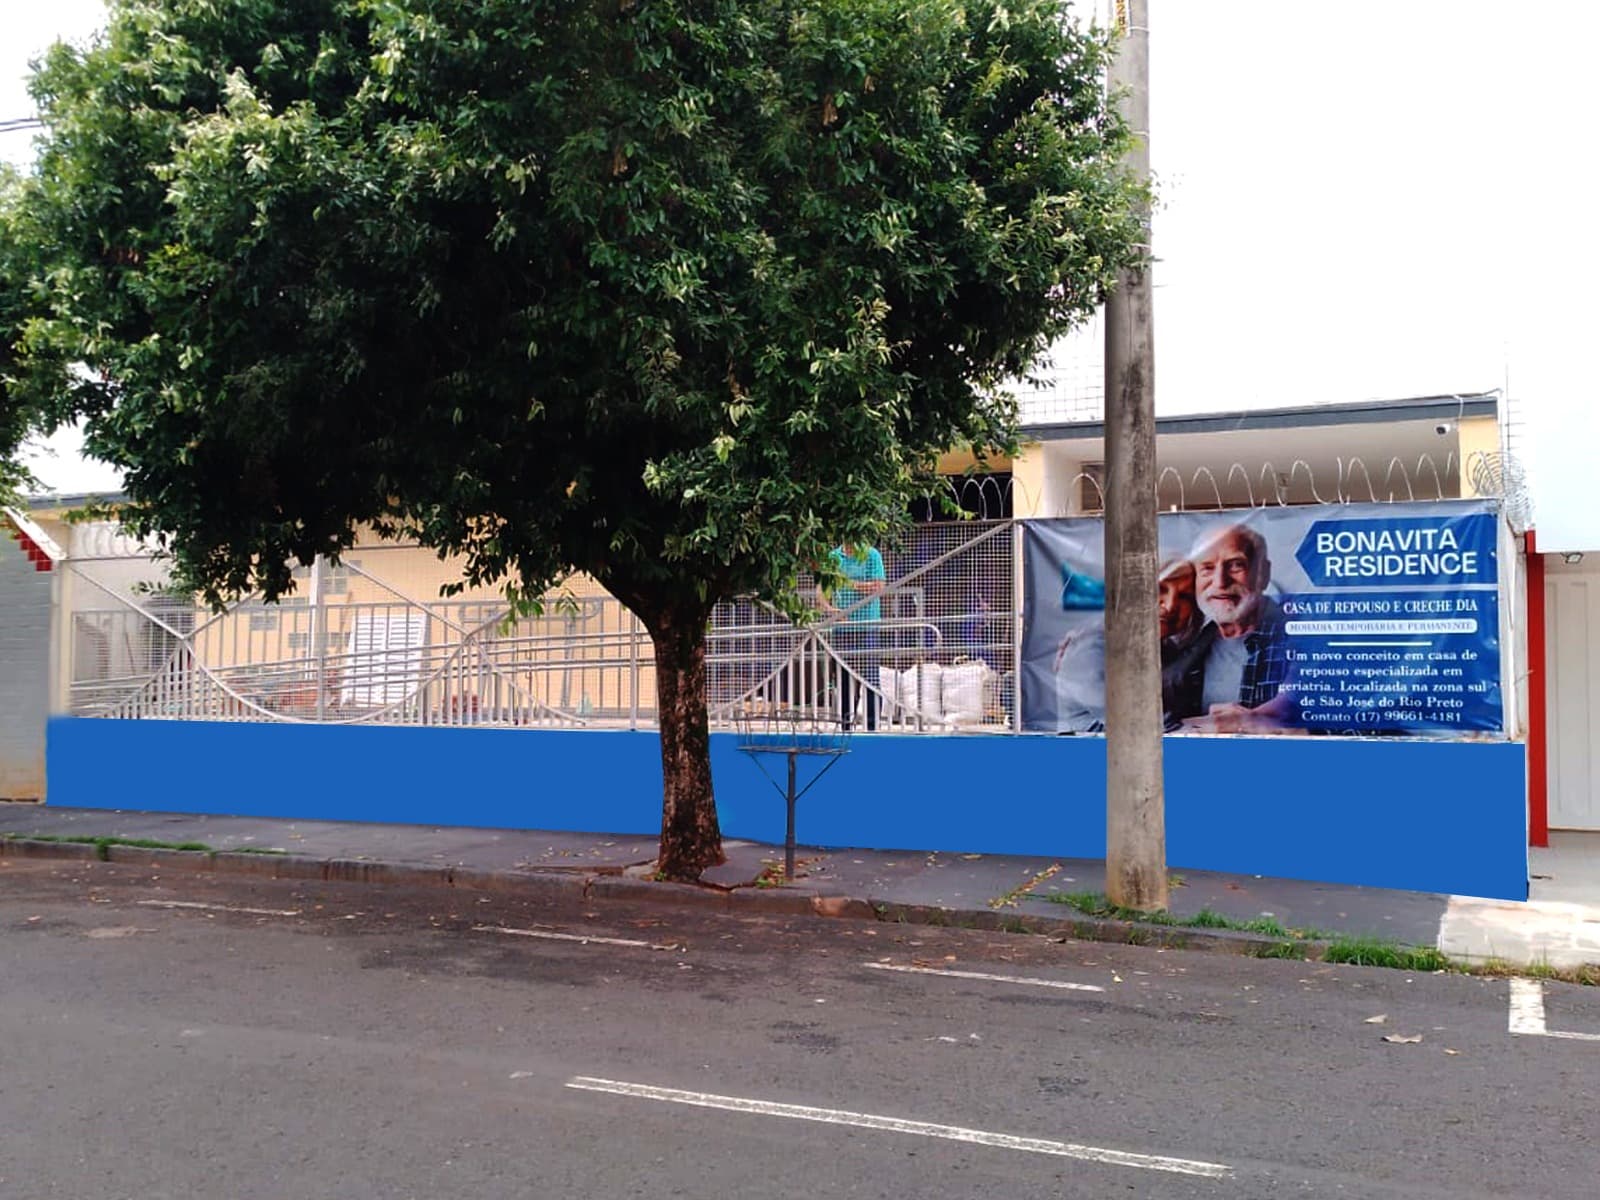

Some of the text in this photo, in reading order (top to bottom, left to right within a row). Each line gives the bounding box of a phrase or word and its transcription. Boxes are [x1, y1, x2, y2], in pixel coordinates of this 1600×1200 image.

[1317, 529, 1458, 553] BONAVITA
[1326, 552, 1477, 577] RESIDENCE
[1283, 602, 1312, 614] CASA
[1316, 602, 1331, 613] DE
[1335, 601, 1389, 613] REPOUSO
[1405, 600, 1452, 612] CRECHE
[1456, 599, 1478, 611] DIA
[1286, 649, 1477, 661] Um novo conceito em casa de
[1300, 665, 1462, 678] repouso especializada em
[1340, 681, 1407, 692] Localizada
[1412, 684, 1428, 692] na
[1432, 683, 1463, 692] zona
[1467, 681, 1486, 692] sul
[1300, 696, 1463, 708] de São José do Rio Preto
[1302, 711, 1461, 723] Contato (17) 99661-4181
